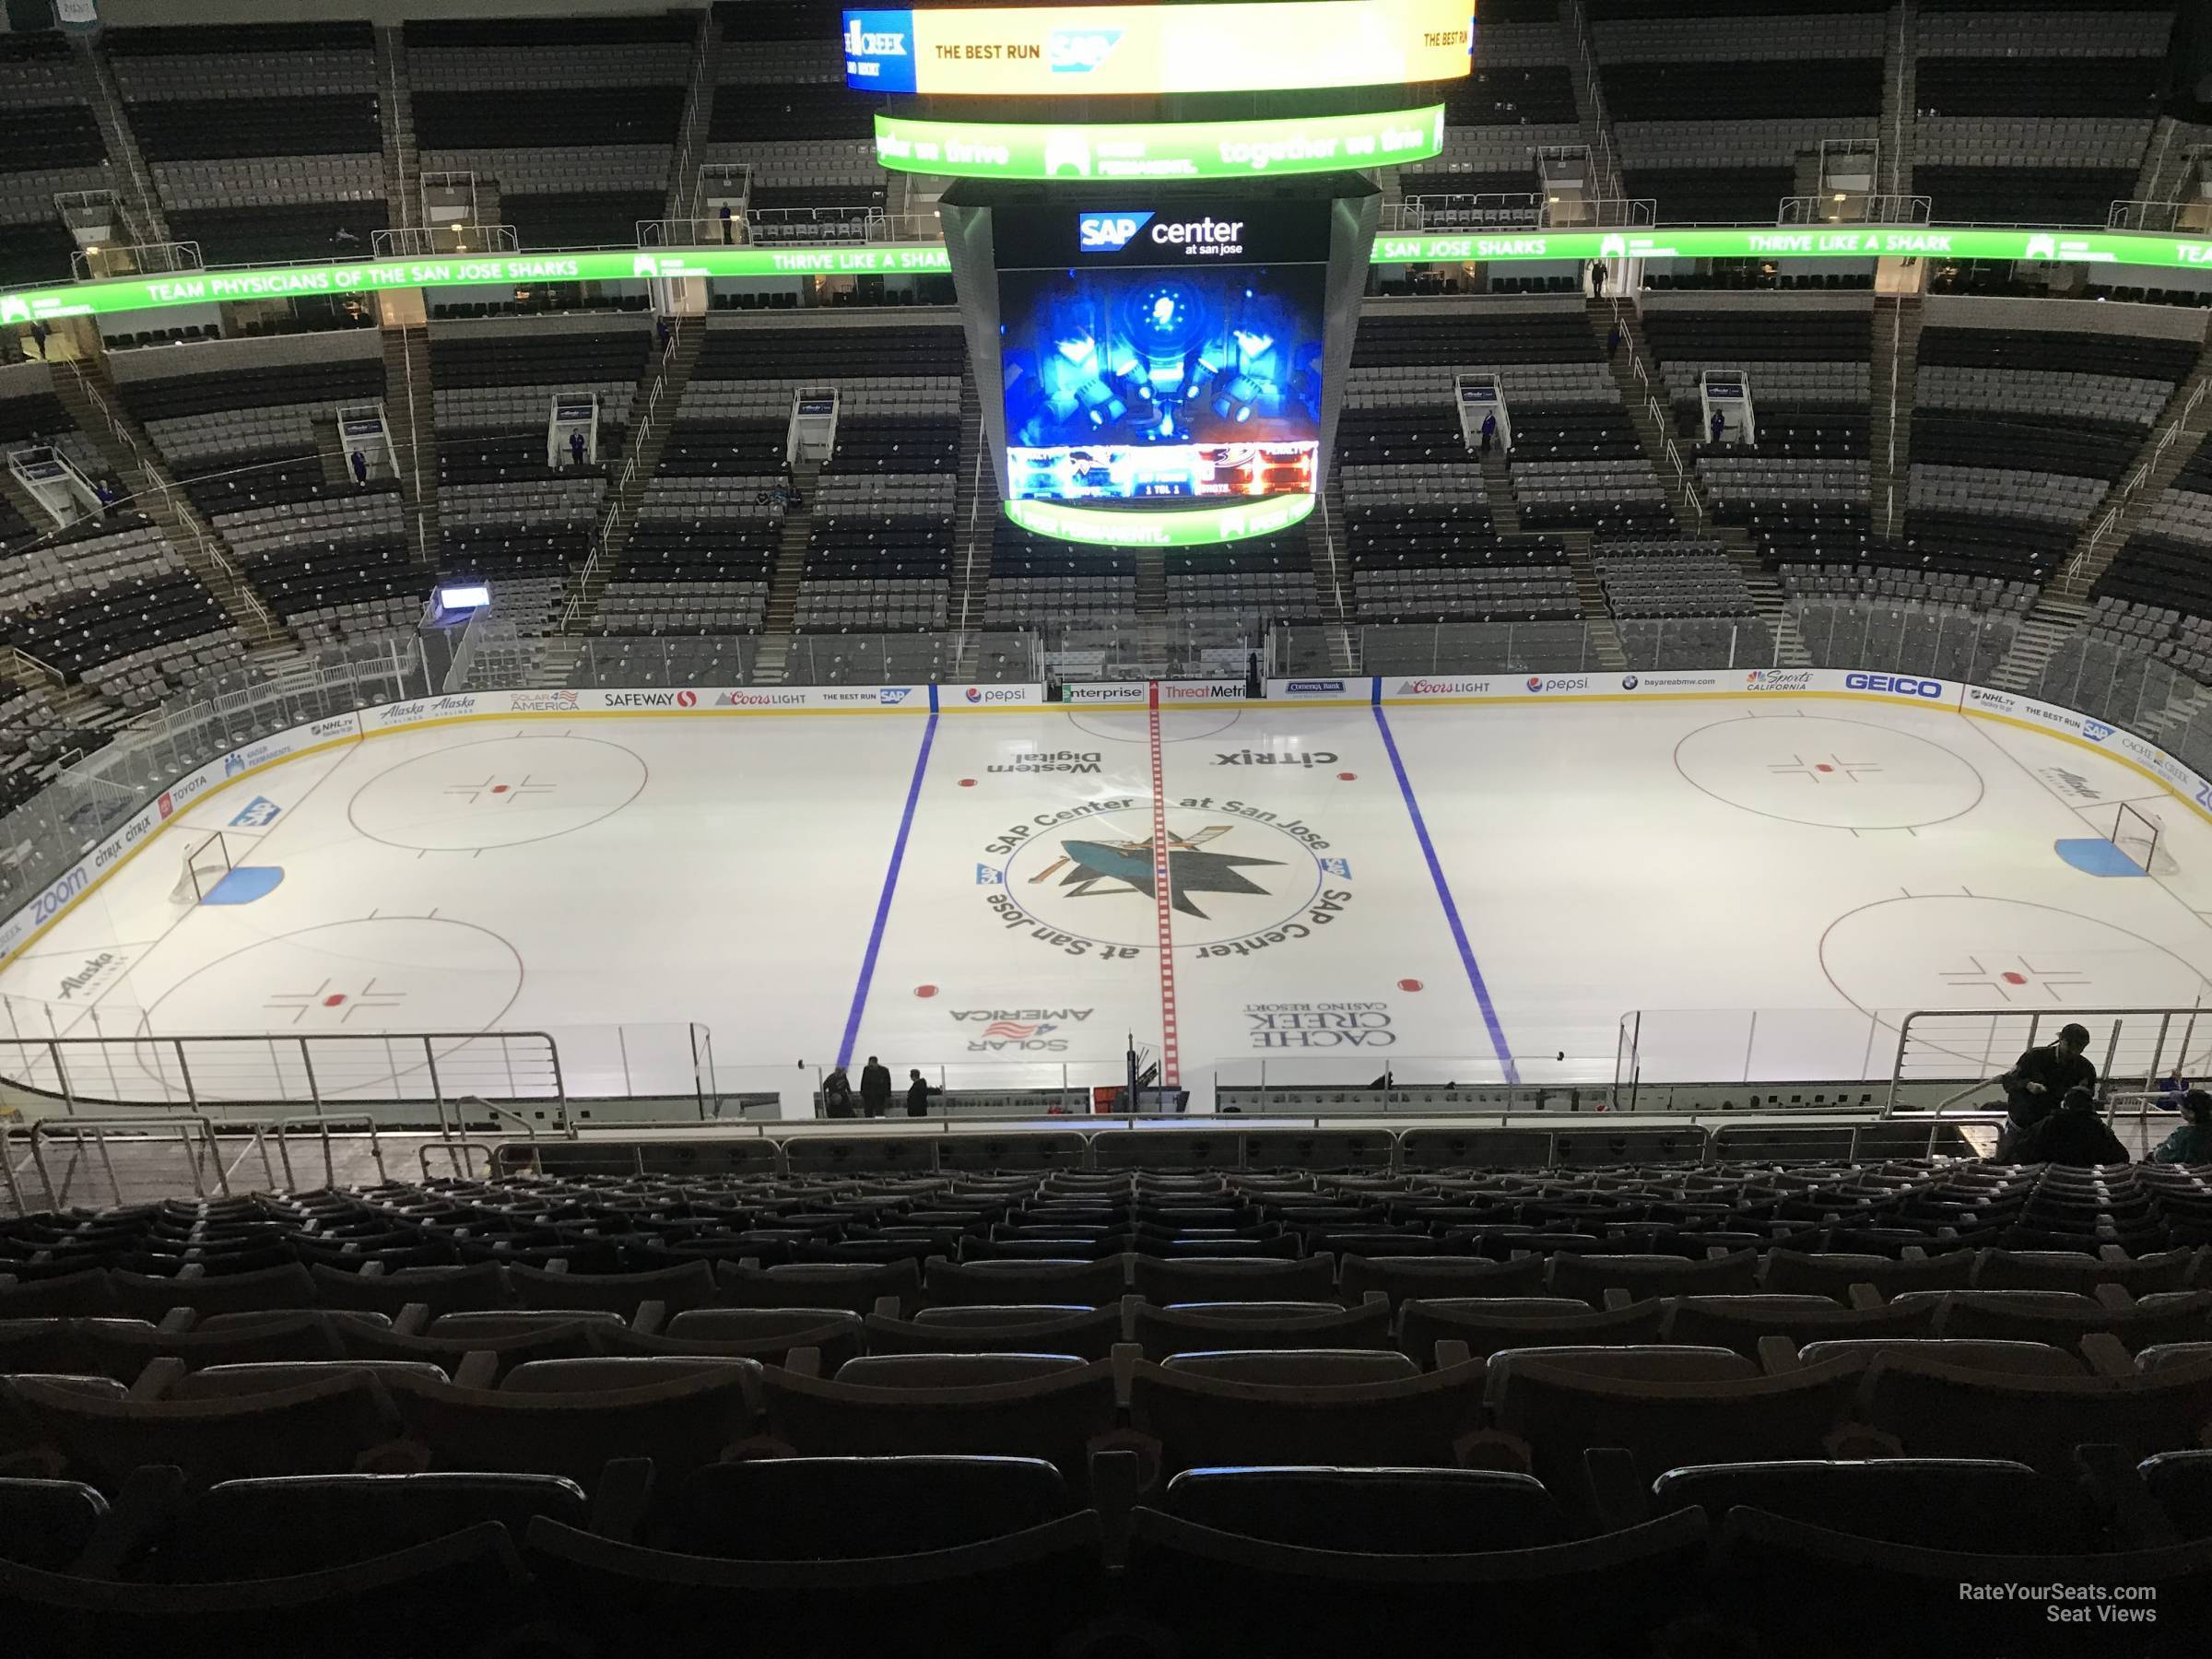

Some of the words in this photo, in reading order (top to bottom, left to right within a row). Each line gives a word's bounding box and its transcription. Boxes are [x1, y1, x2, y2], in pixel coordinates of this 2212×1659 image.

[935, 45, 961, 59] THE
[966, 44, 1002, 59] BEST
[1007, 44, 1041, 59] RUN
[1219, 134, 1338, 169] together
[1080, 218, 1137, 245] SAP
[1151, 217, 1244, 244] center
[1185, 244, 1197, 254] at
[1199, 244, 1219, 255] san
[1219, 243, 1243, 256] jose
[1383, 242, 1420, 259] SAN
[1427, 241, 1470, 257] JOSE
[1477, 239, 1547, 256] SHARKS
[1747, 236, 1813, 252] THRIVE
[1818, 236, 1854, 251] LIKE
[1863, 236, 1879, 251] A
[1886, 236, 1952, 253] SHARK
[772, 253, 834, 270] THRIVE
[840, 253, 877, 269] LIKE
[883, 253, 896, 268] A
[147, 282, 206, 301] TEAM
[211, 272, 329, 297] PHYSICIANS
[335, 271, 362, 288] OF
[369, 268, 407, 286] THE
[411, 265, 450, 283] SAN
[456, 263, 501, 281] JOSE
[508, 259, 579, 278] SHARKS
[1413, 679, 1453, 693] Coors
[1454, 682, 1490, 693] LIGHT
[1546, 677, 1588, 692] pepsi
[1644, 677, 1715, 687] bayareabmw.com
[1765, 670, 1814, 686] Sports
[1845, 674, 1941, 699] GEICO
[984, 688, 1025, 702] pepsi
[1747, 683, 1806, 691] CALIFORNIA
[430, 696, 476, 711] Alaska
[605, 693, 674, 707] SAFEWAY
[730, 691, 771, 705] Coors
[771, 694, 806, 705] LIGHT
[880, 690, 905, 703] SAP
[380, 703, 424, 719] Alaska
[511, 701, 580, 711] AMERICA
[2025, 706, 2041, 717] THE
[2043, 711, 2063, 724] BEST
[2065, 718, 2081, 729] RUN
[2084, 721, 2109, 740] SAP
[1016, 750, 1101, 764] Digital
[987, 763, 1101, 774] Western
[172, 776, 207, 803] TOYOTA
[235, 798, 279, 827] SAP
[984, 825, 1030, 854] SAP
[1033, 797, 1135, 827] Center
[1179, 797, 1215, 809] at
[1220, 800, 1277, 822] San
[1277, 819, 1331, 851] Jose
[980, 863, 1000, 884] SAP
[1323, 857, 1347, 877] SAP
[29, 866, 88, 925] zoom
[986, 893, 1036, 929] Jose
[1308, 888, 1353, 925] SAP
[1030, 926, 1093, 956] San
[1195, 924, 1311, 959] Center
[1099, 944, 1140, 960] at
[57, 952, 114, 1000] Alaska
[949, 1007, 1095, 1022] AMERICA
[1242, 1004, 1312, 1013] RESORT
[1317, 1002, 1388, 1011] CASINO
[1244, 1012, 1392, 1030] CREEK
[966, 1039, 1069, 1052] SOLAR
[1249, 1030, 1397, 1049] CACHE
